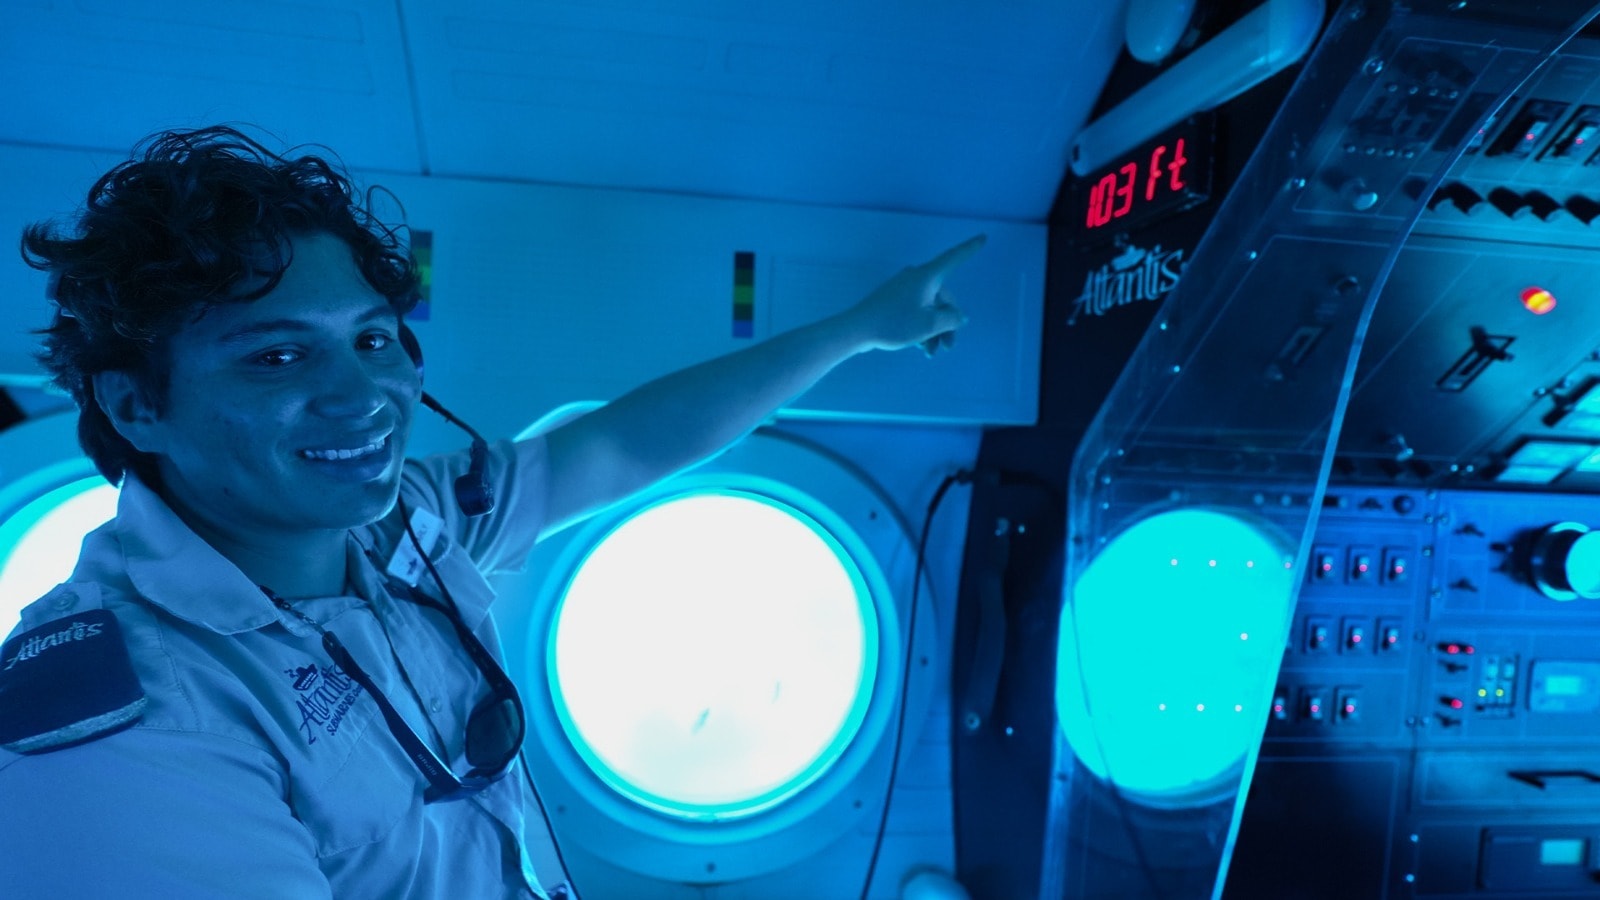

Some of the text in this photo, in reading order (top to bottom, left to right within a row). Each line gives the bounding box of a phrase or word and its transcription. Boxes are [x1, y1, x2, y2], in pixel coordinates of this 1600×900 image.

[1086, 162, 1137, 228] 103
[1067, 244, 1184, 325] Atlantis
[3, 622, 104, 671] Atlantis
